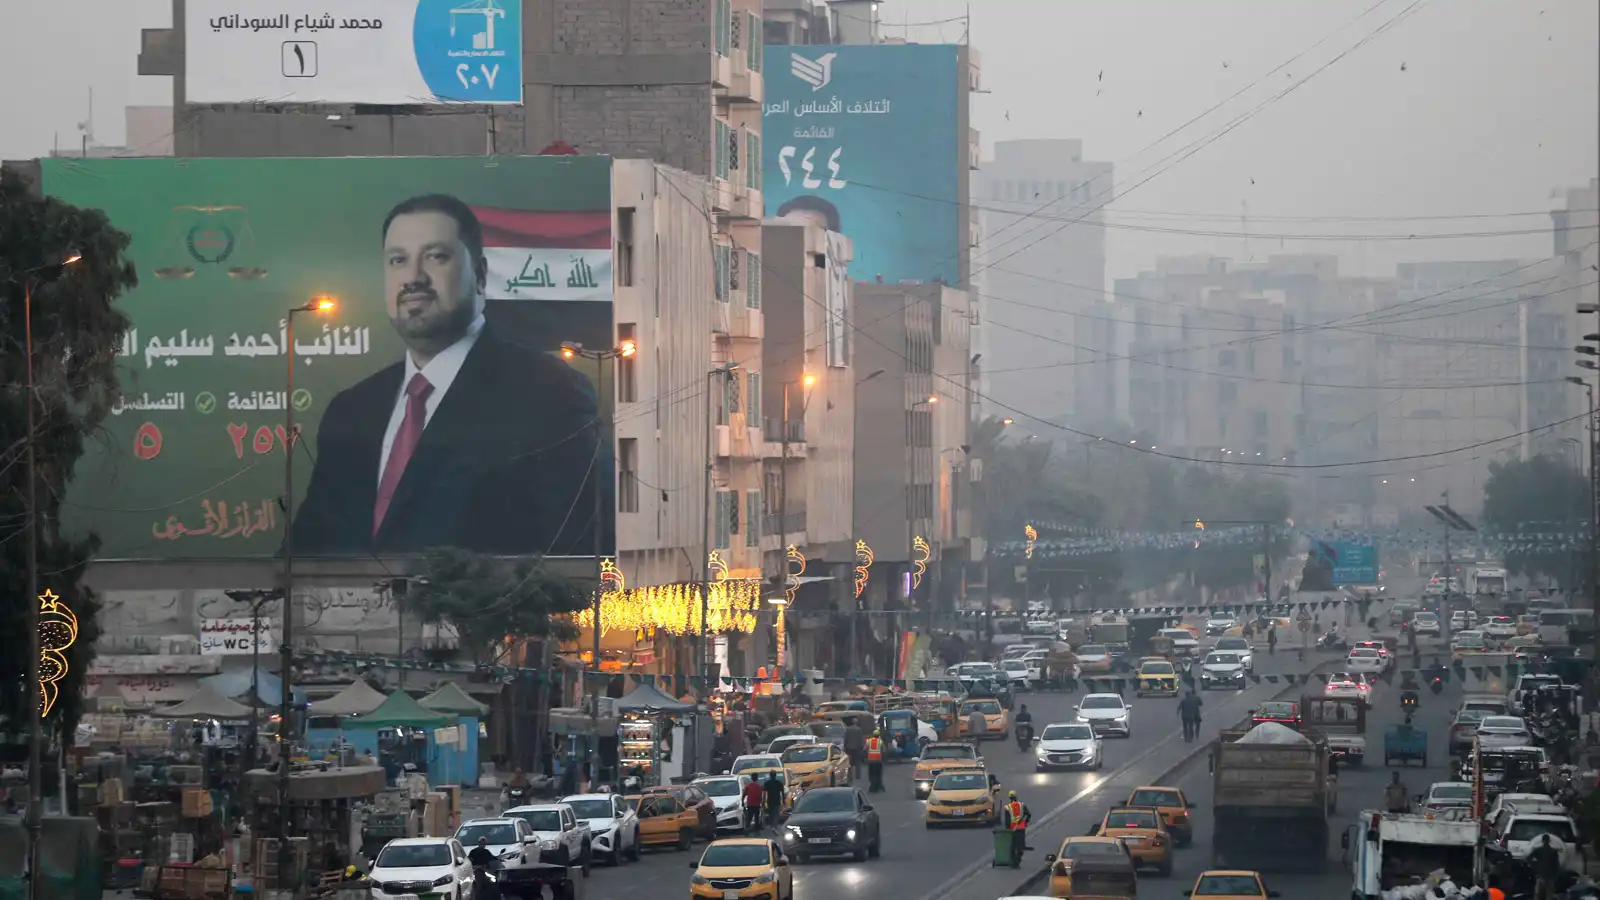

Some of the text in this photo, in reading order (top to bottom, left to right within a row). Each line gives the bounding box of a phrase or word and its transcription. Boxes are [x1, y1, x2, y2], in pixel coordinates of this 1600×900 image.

[210, 12, 383, 33] محمد شياع السوداني
[294, 43, 304, 74] ١
[456, 63, 499, 90] ٢٠٧
[794, 95, 842, 117] الأساس
[793, 125, 835, 139] القائمة
[778, 145, 847, 189] ٢٤٤
[145, 328, 214, 369] سليم
[224, 318, 287, 358] أحمد
[294, 323, 370, 366] النائب
[227, 391, 287, 410] القائمة
[134, 421, 162, 460] ٥
[224, 639, 249, 649] WC
